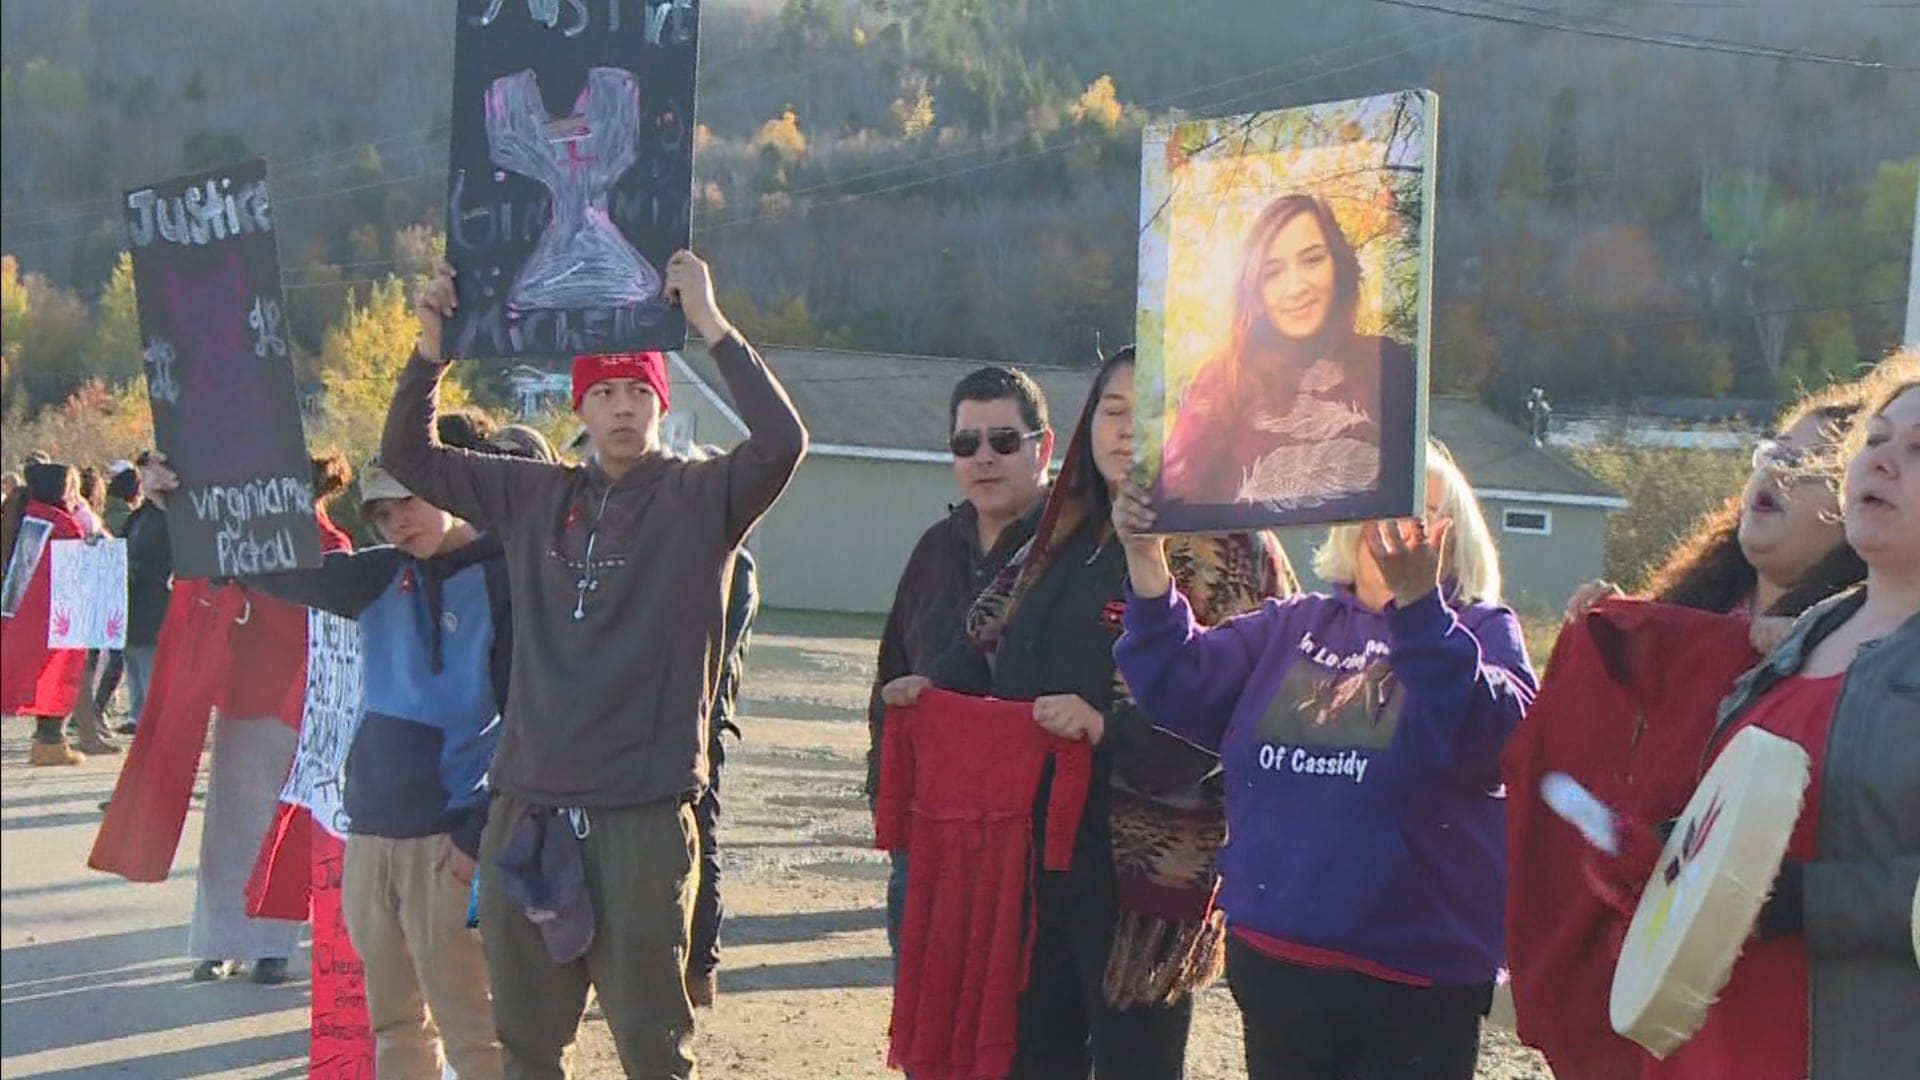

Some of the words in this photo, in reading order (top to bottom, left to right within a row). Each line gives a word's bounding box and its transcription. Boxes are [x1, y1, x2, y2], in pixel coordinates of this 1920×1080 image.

[127, 178, 271, 246] Justice
[1259, 744, 1288, 771] Of
[1291, 748, 1369, 783] Cassidy
